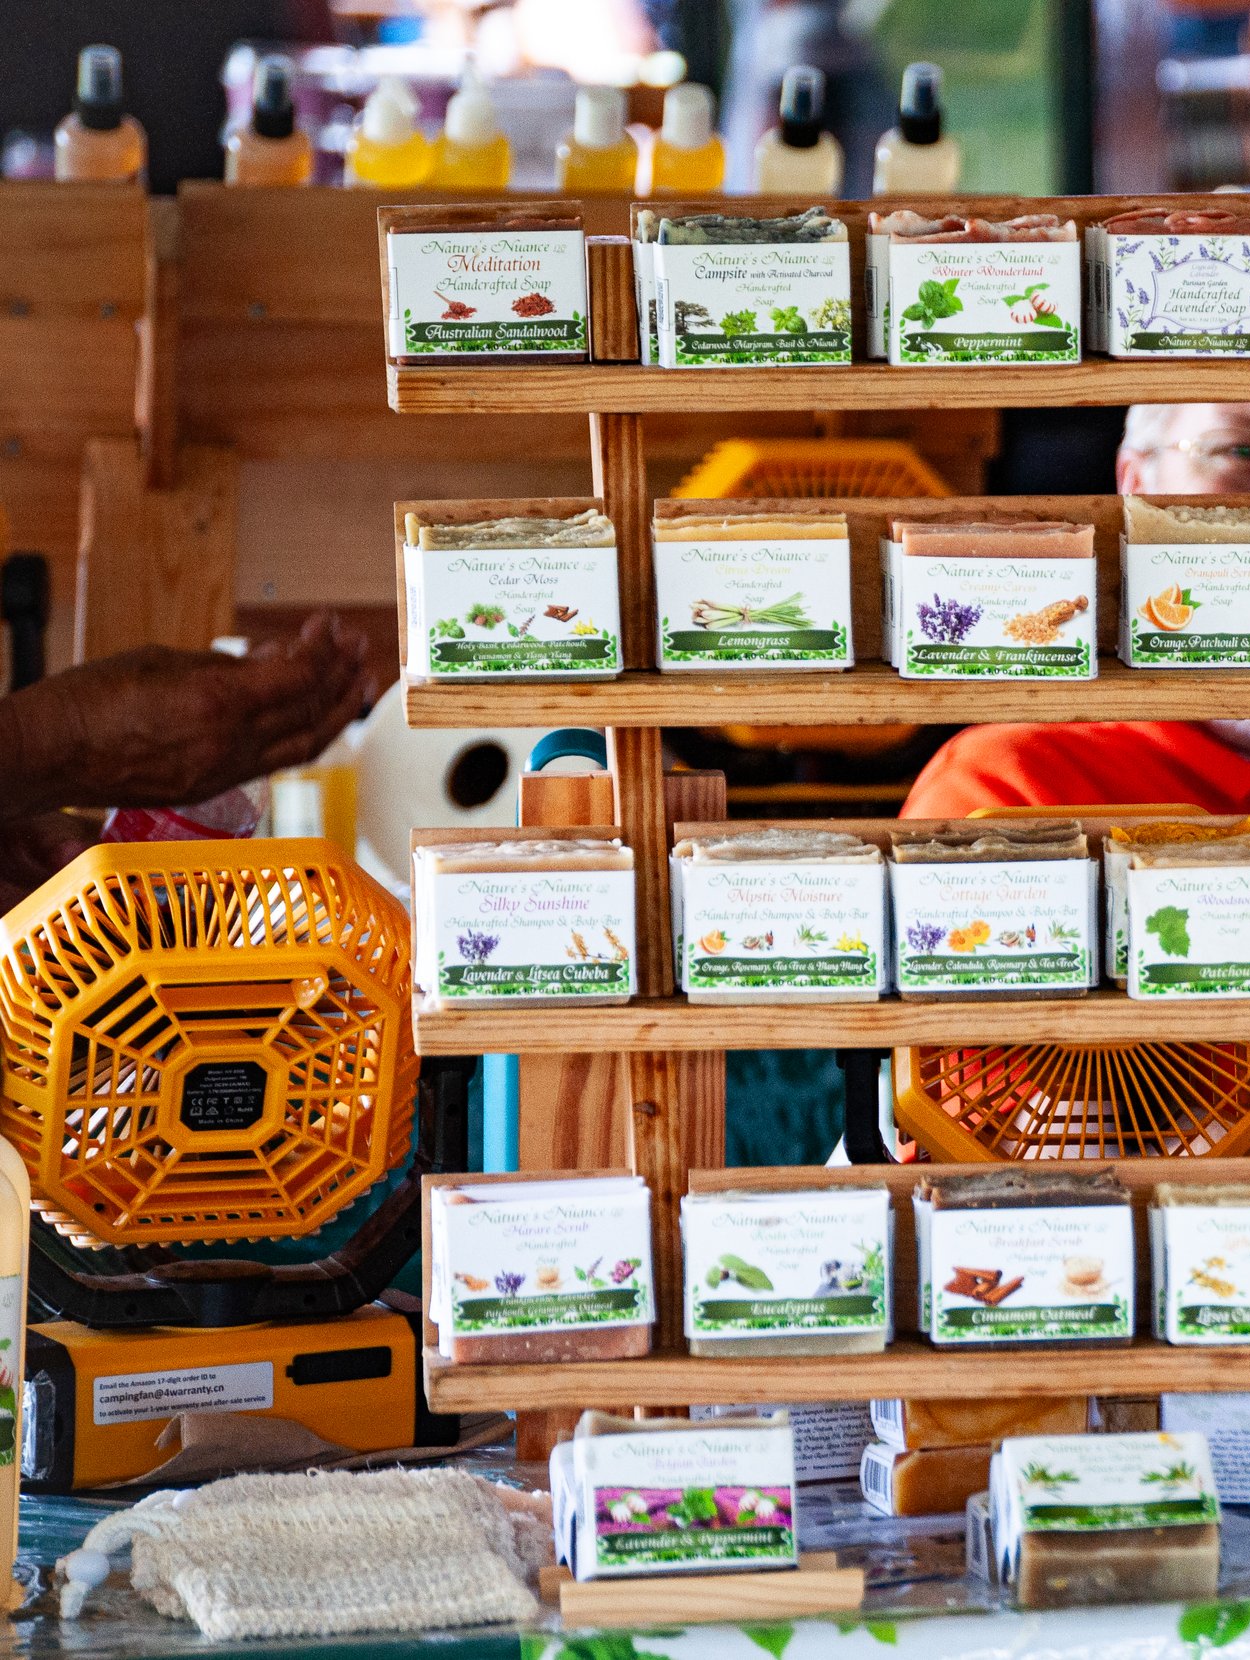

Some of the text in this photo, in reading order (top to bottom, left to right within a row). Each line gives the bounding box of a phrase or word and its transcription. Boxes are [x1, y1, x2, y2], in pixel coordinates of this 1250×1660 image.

[421, 240, 549, 254] Nature's Nuance
[447, 254, 540, 273] Meditation
[692, 251, 817, 266] Nature's Nuance
[918, 251, 1043, 264] Nature's Nuance
[695, 266, 747, 282] Campsite
[767, 270, 801, 278] Activated
[803, 269, 833, 277] Charcoal
[932, 266, 1043, 277] Winter Wonderland
[436, 276, 551, 295] Handcrafted Soap
[1169, 288, 1243, 300] Handcrafted
[1163, 302, 1246, 315] Lavender Soap
[426, 323, 567, 340] Australian Sandalwood
[776, 340, 795, 348] Basil
[797, 340, 804, 348] &
[954, 337, 1022, 349] Peppermint
[1159, 336, 1247, 347] Nature's Nuance LLC
[681, 548, 810, 562] Nature's Nuance
[1151, 551, 1216, 565] Nature's
[448, 557, 579, 572] Nature's Nuance
[927, 563, 1056, 578] Nature's Nuance
[489, 575, 558, 585] Cedar Moss
[718, 635, 790, 647] Lemongrass
[1188, 636, 1238, 647] Patchouli
[1241, 638, 1250, 647] &
[917, 650, 1077, 664] Lavender & Frankincense
[708, 873, 840, 887] Nature's Nuance
[920, 871, 1049, 886] Nature's Nuance
[1156, 879, 1222, 893] Nature's
[458, 880, 592, 895] Nature's Nuance
[940, 886, 1047, 904] Cottage Garden
[479, 894, 590, 915] Silky Sunshine
[728, 889, 843, 906] Mystic Moisture
[695, 909, 869, 924] Handcrafted Shampoo & Body Bar
[906, 908, 968, 921] Handcrafted
[971, 906, 1012, 920] Shampoo
[1015, 906, 1026, 917] &
[1030, 906, 1056, 918] Body
[444, 915, 622, 932] Handcrafted Shampoo & Body Bar
[987, 959, 1026, 972] Rosemary
[1029, 960, 1038, 969] &
[1040, 959, 1054, 968] Tea
[1056, 958, 1074, 968] Tree
[460, 966, 609, 983] Lavender & Litsea Cubeba
[751, 1303, 826, 1316] Eucalyptus
[972, 1308, 1096, 1324] Cinnamon Oatmeal
[130, 1380, 156, 1388] Amazon
[158, 1376, 181, 1386] 17-digit
[99, 1384, 224, 1405] campingfan@4warranty.cn
[134, 1406, 149, 1416] your
[150, 1404, 169, 1413] 1-year
[171, 1402, 199, 1411] warranty
[214, 1398, 242, 1406] after-sale
[244, 1395, 265, 1403] service
[616, 1531, 772, 1550] Lavender & Peppermint
